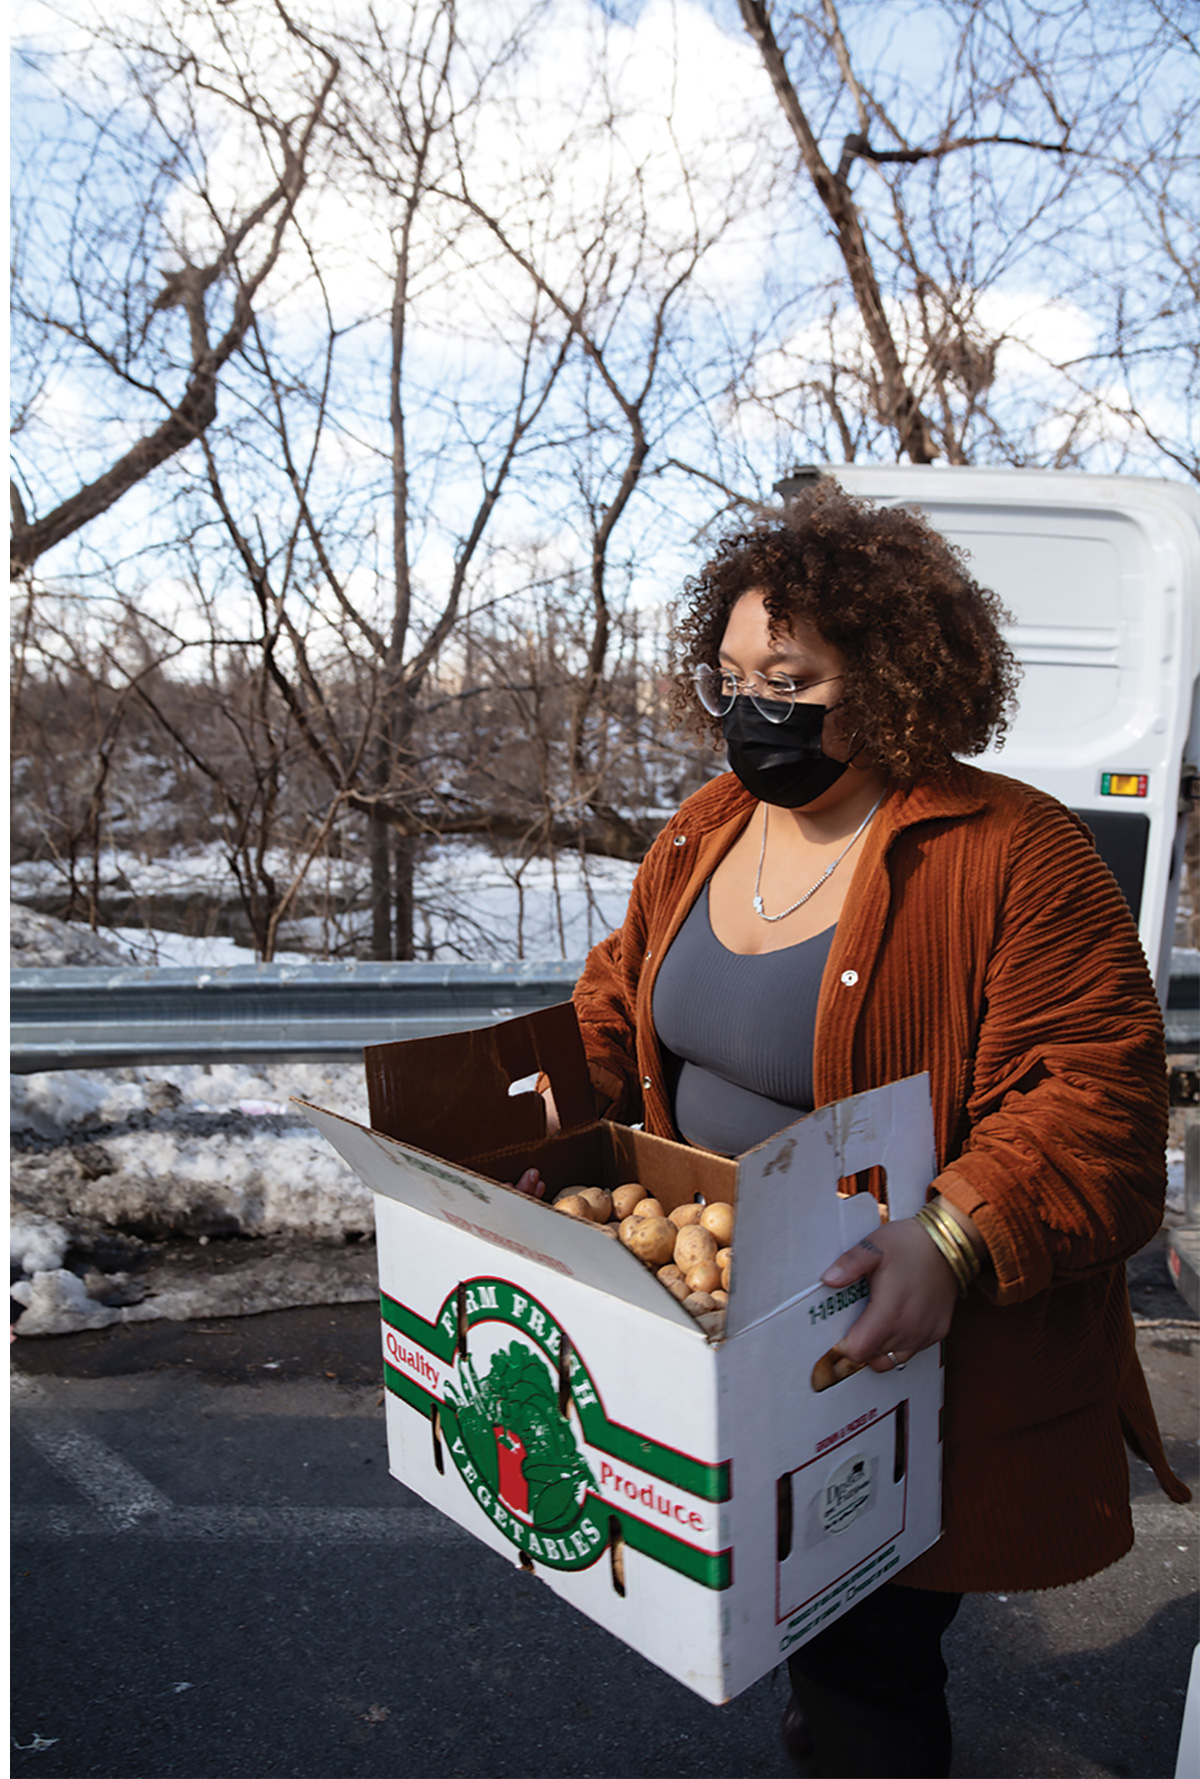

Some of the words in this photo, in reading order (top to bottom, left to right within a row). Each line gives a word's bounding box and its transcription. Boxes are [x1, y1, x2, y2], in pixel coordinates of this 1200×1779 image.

[386, 1332, 440, 1389] Quality
[451, 1437, 601, 1561] VEGETABLES
[600, 1461, 706, 1532] Produce
